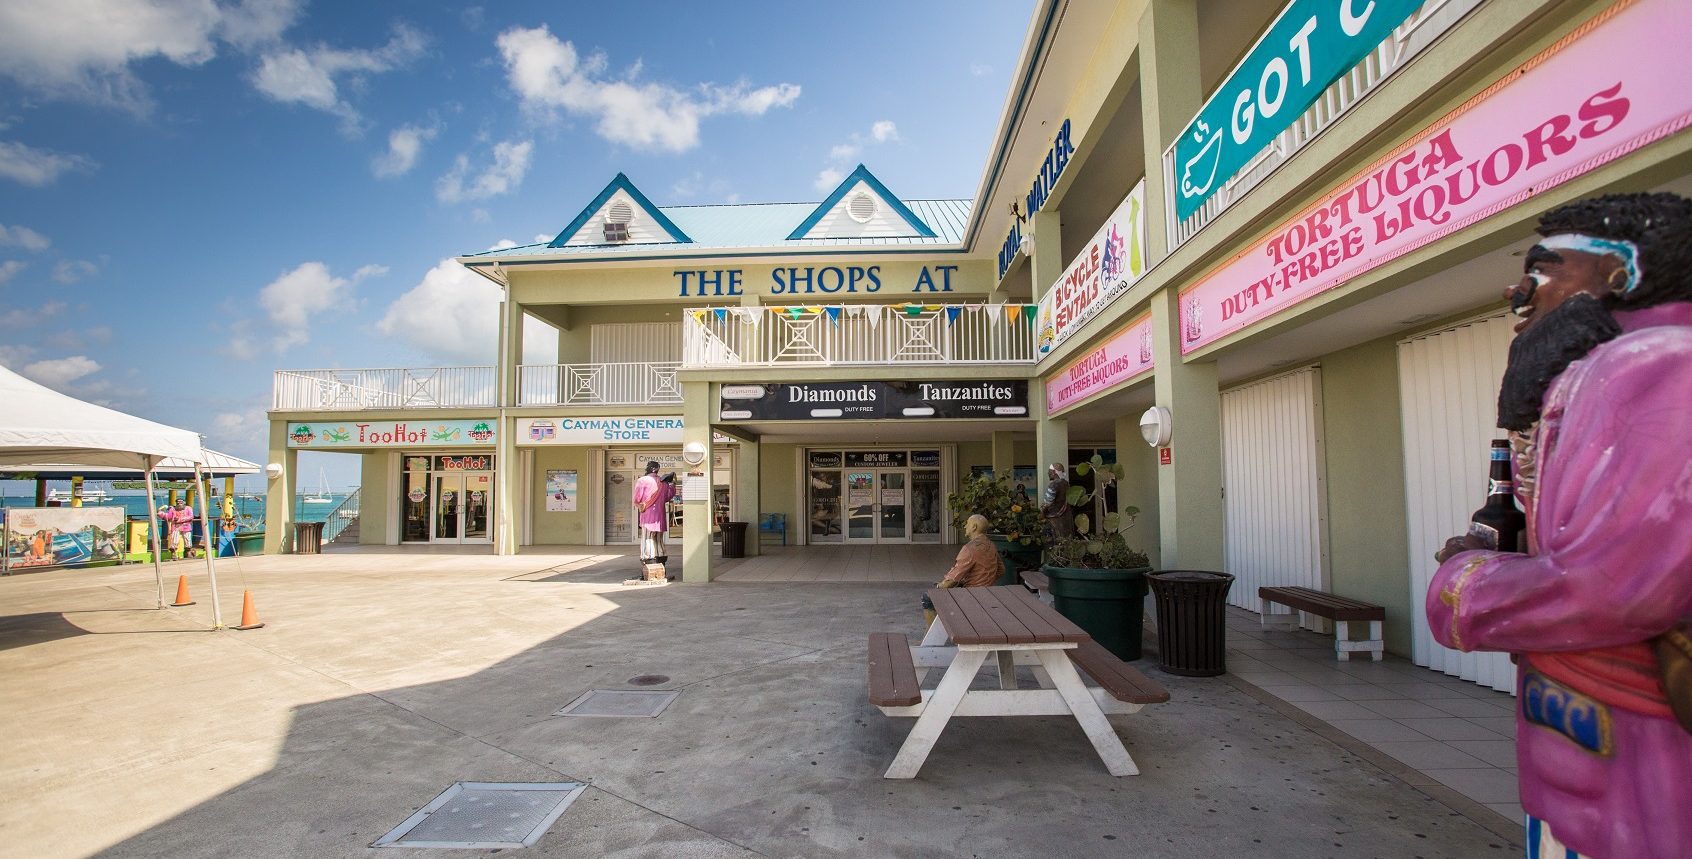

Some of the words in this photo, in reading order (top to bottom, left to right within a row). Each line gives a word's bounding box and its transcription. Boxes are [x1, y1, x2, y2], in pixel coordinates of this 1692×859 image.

[1231, 14, 1317, 145] GOT
[997, 216, 1022, 281] ROYAL
[1026, 118, 1075, 220] WATLER
[1220, 226, 1365, 322] DUTY-FREE
[1372, 80, 1631, 246] LIQUORS
[1266, 127, 1463, 267] TORTUGA
[673, 269, 744, 297] THE
[771, 265, 882, 294] SHOPS
[912, 265, 959, 293] AT
[1055, 243, 1099, 310] BICYCLE
[1055, 275, 1099, 334] RENTALS
[1058, 375, 1091, 402] DUTY-FREE
[1092, 354, 1129, 385] LIQUORS
[1069, 347, 1107, 381] TORTUGA
[788, 384, 877, 403] Diamonds
[918, 382, 1012, 401] Tanzanites
[355, 423, 427, 444] TooHot
[562, 418, 620, 430] CAYMAN
[603, 429, 650, 440] STORE
[441, 456, 486, 469] TooHot
[863, 453, 877, 462] 60%
[878, 453, 889, 462] OFF
